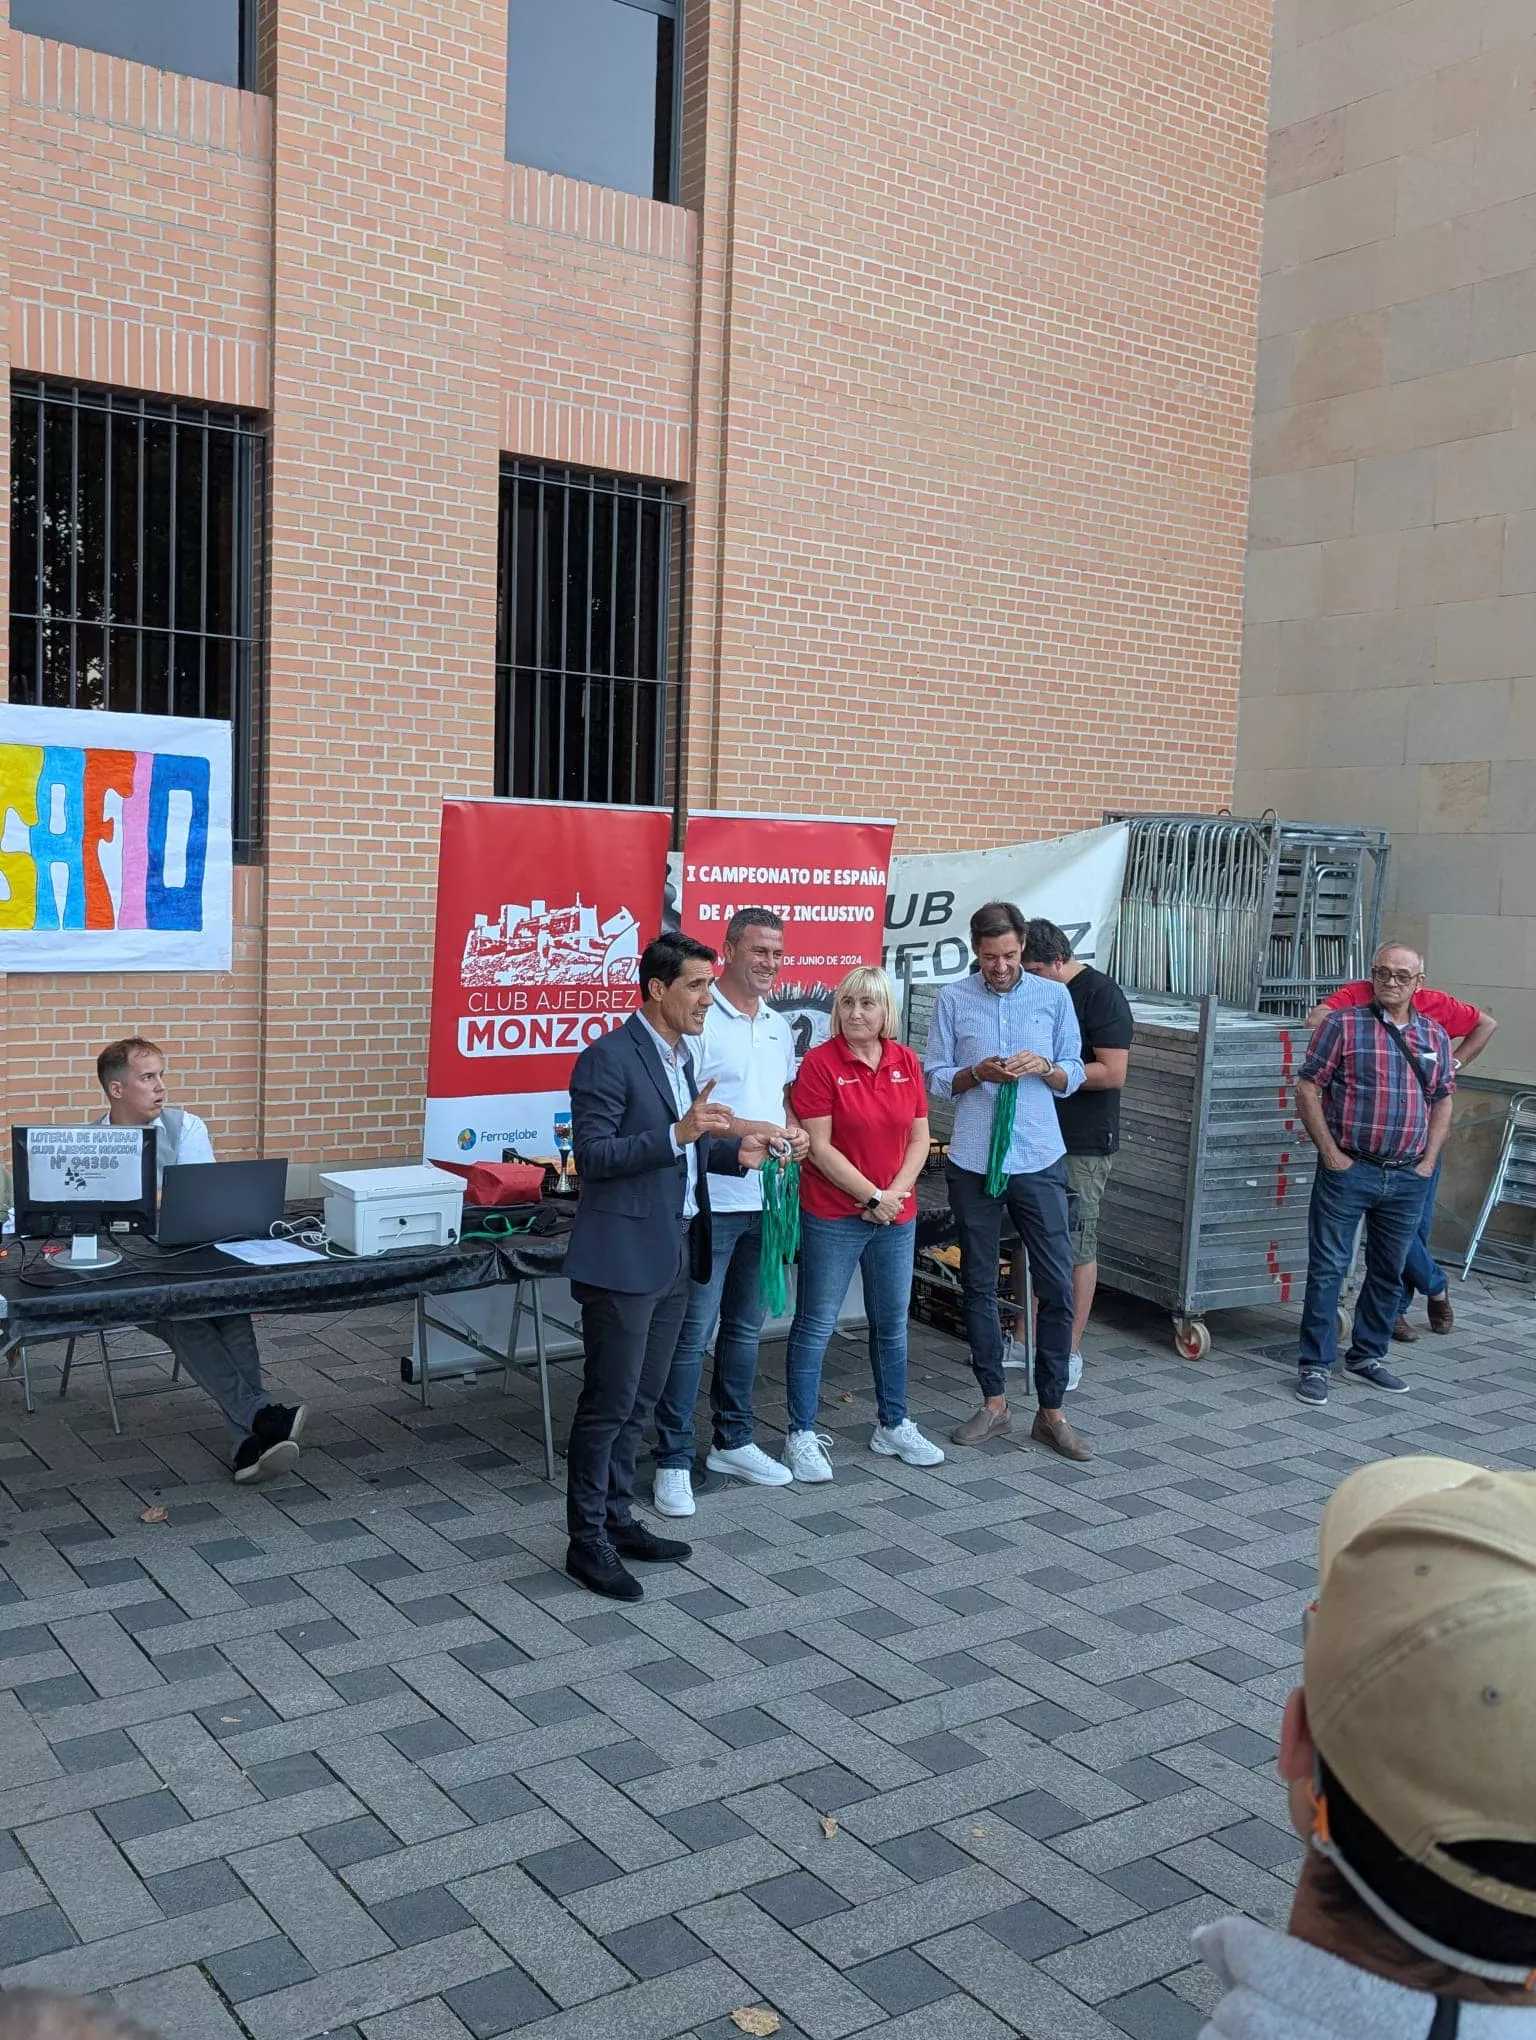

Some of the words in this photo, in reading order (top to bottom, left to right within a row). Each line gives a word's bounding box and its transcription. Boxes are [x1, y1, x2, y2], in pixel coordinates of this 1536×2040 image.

[686, 865, 696, 882] I
[699, 866, 810, 885] CAMPEONATO
[813, 868, 830, 885] DE
[834, 866, 886, 886] ESPAÑA
[699, 904, 720, 921] DE
[793, 904, 875, 922] INCLUSIVO
[883, 890, 956, 930] UB
[783, 956, 795, 966] DE
[797, 956, 825, 966] JUNIO
[826, 956, 838, 966] DE
[840, 955, 862, 966] 2024
[468, 991, 528, 1012] CLUB
[535, 990, 637, 1011] AJEDREZ
[76, 1132, 91, 1143] DE
[93, 1131, 139, 1143] NAVIDAD
[480, 1128, 538, 1143] Ferroglobe
[31, 1145, 55, 1154] CLUB
[57, 1144, 97, 1155] AJEDREZ
[71, 1156, 119, 1170] 94386
